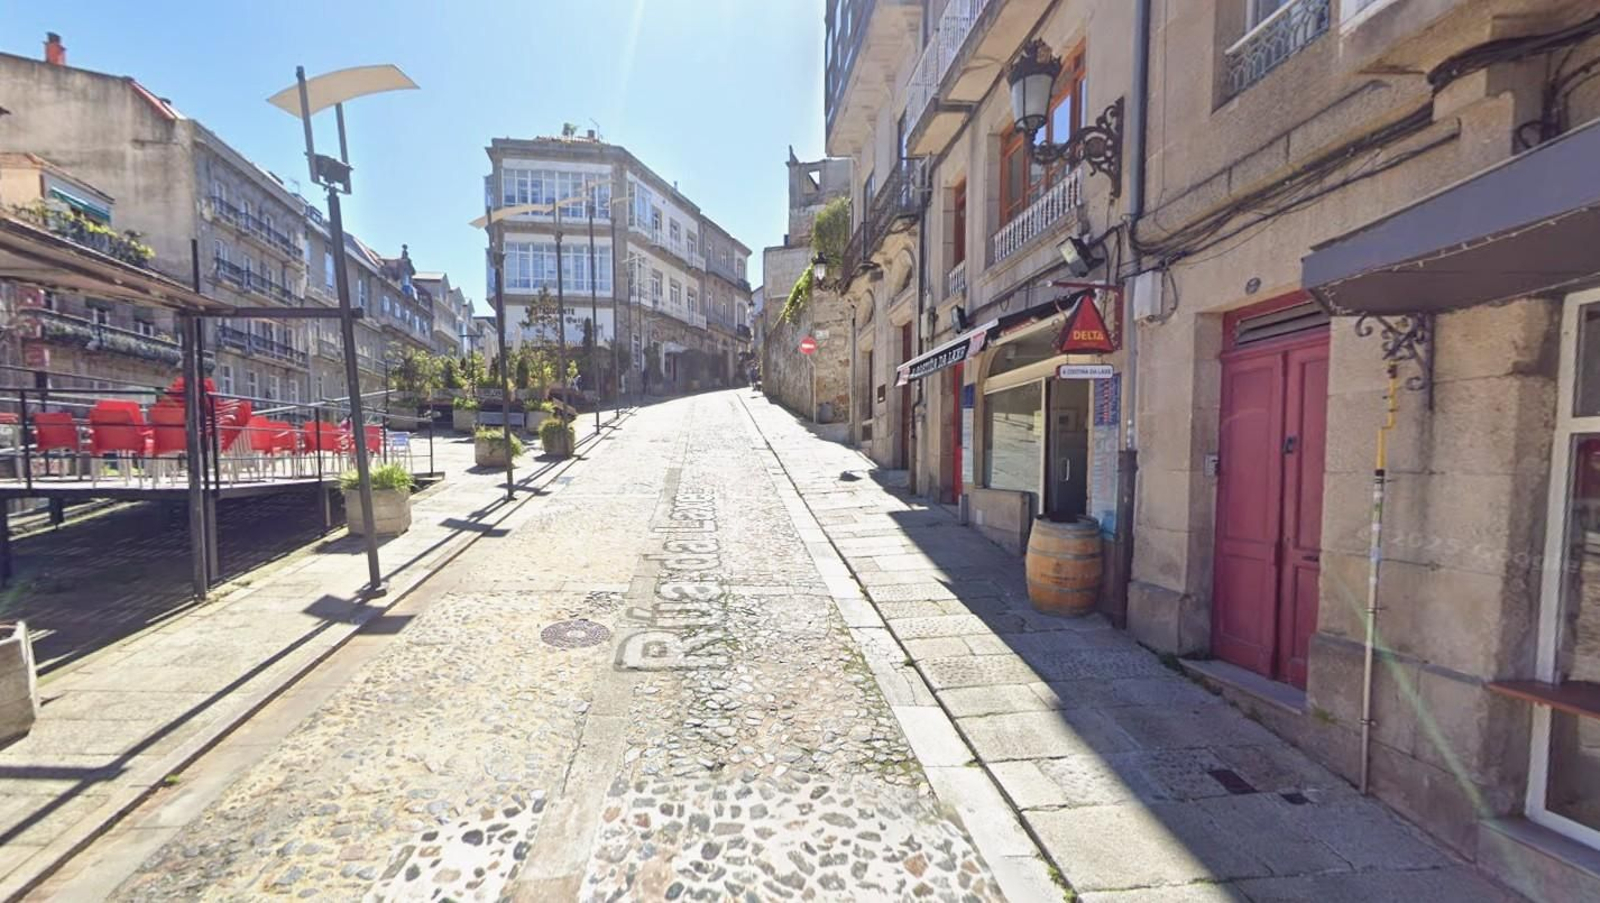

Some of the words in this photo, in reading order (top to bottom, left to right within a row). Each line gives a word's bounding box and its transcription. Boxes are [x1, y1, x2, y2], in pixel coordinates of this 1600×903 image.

[1073, 331, 1104, 341] DELTA
[651, 486, 719, 534] Laxe
[643, 539, 721, 572] da
[613, 579, 732, 672] Rúa
